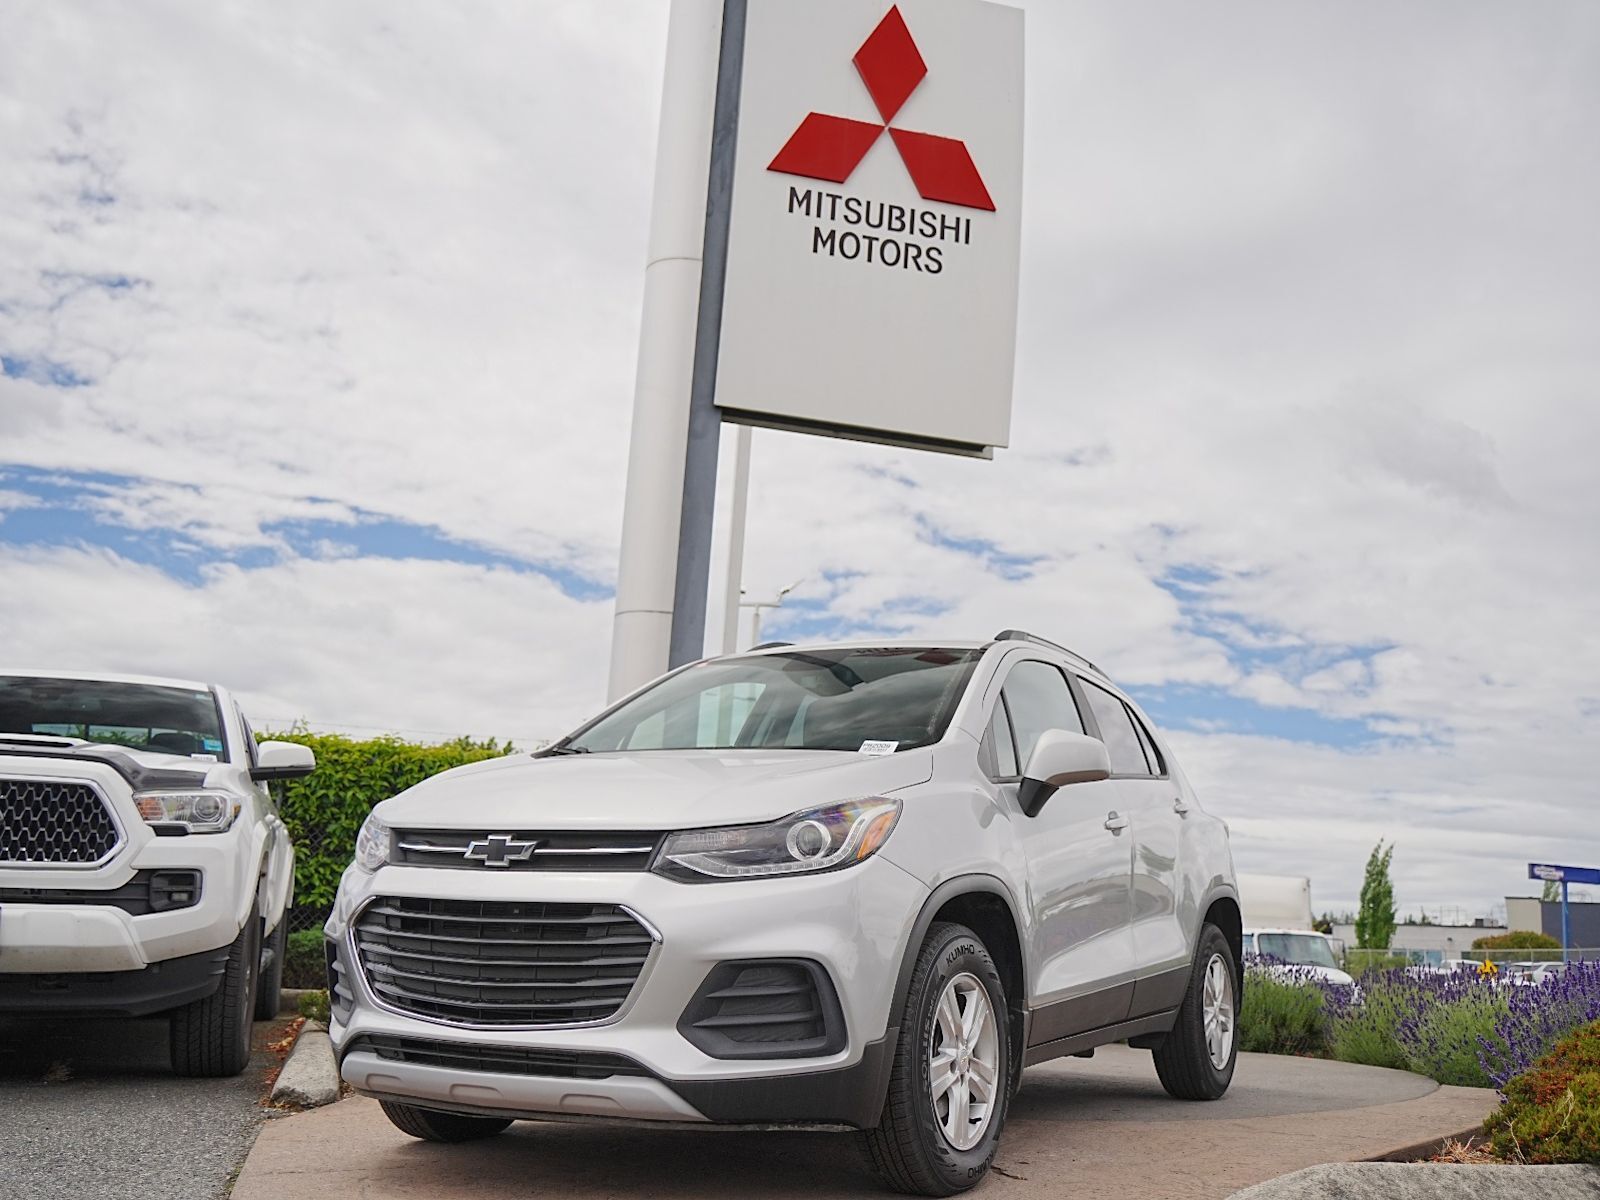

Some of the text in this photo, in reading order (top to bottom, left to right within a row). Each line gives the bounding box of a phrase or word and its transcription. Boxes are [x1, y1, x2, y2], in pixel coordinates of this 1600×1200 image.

[787, 186, 972, 246] MITSUBISHI
[812, 226, 944, 275] MOTORS
[945, 944, 975, 967] KUMHO
